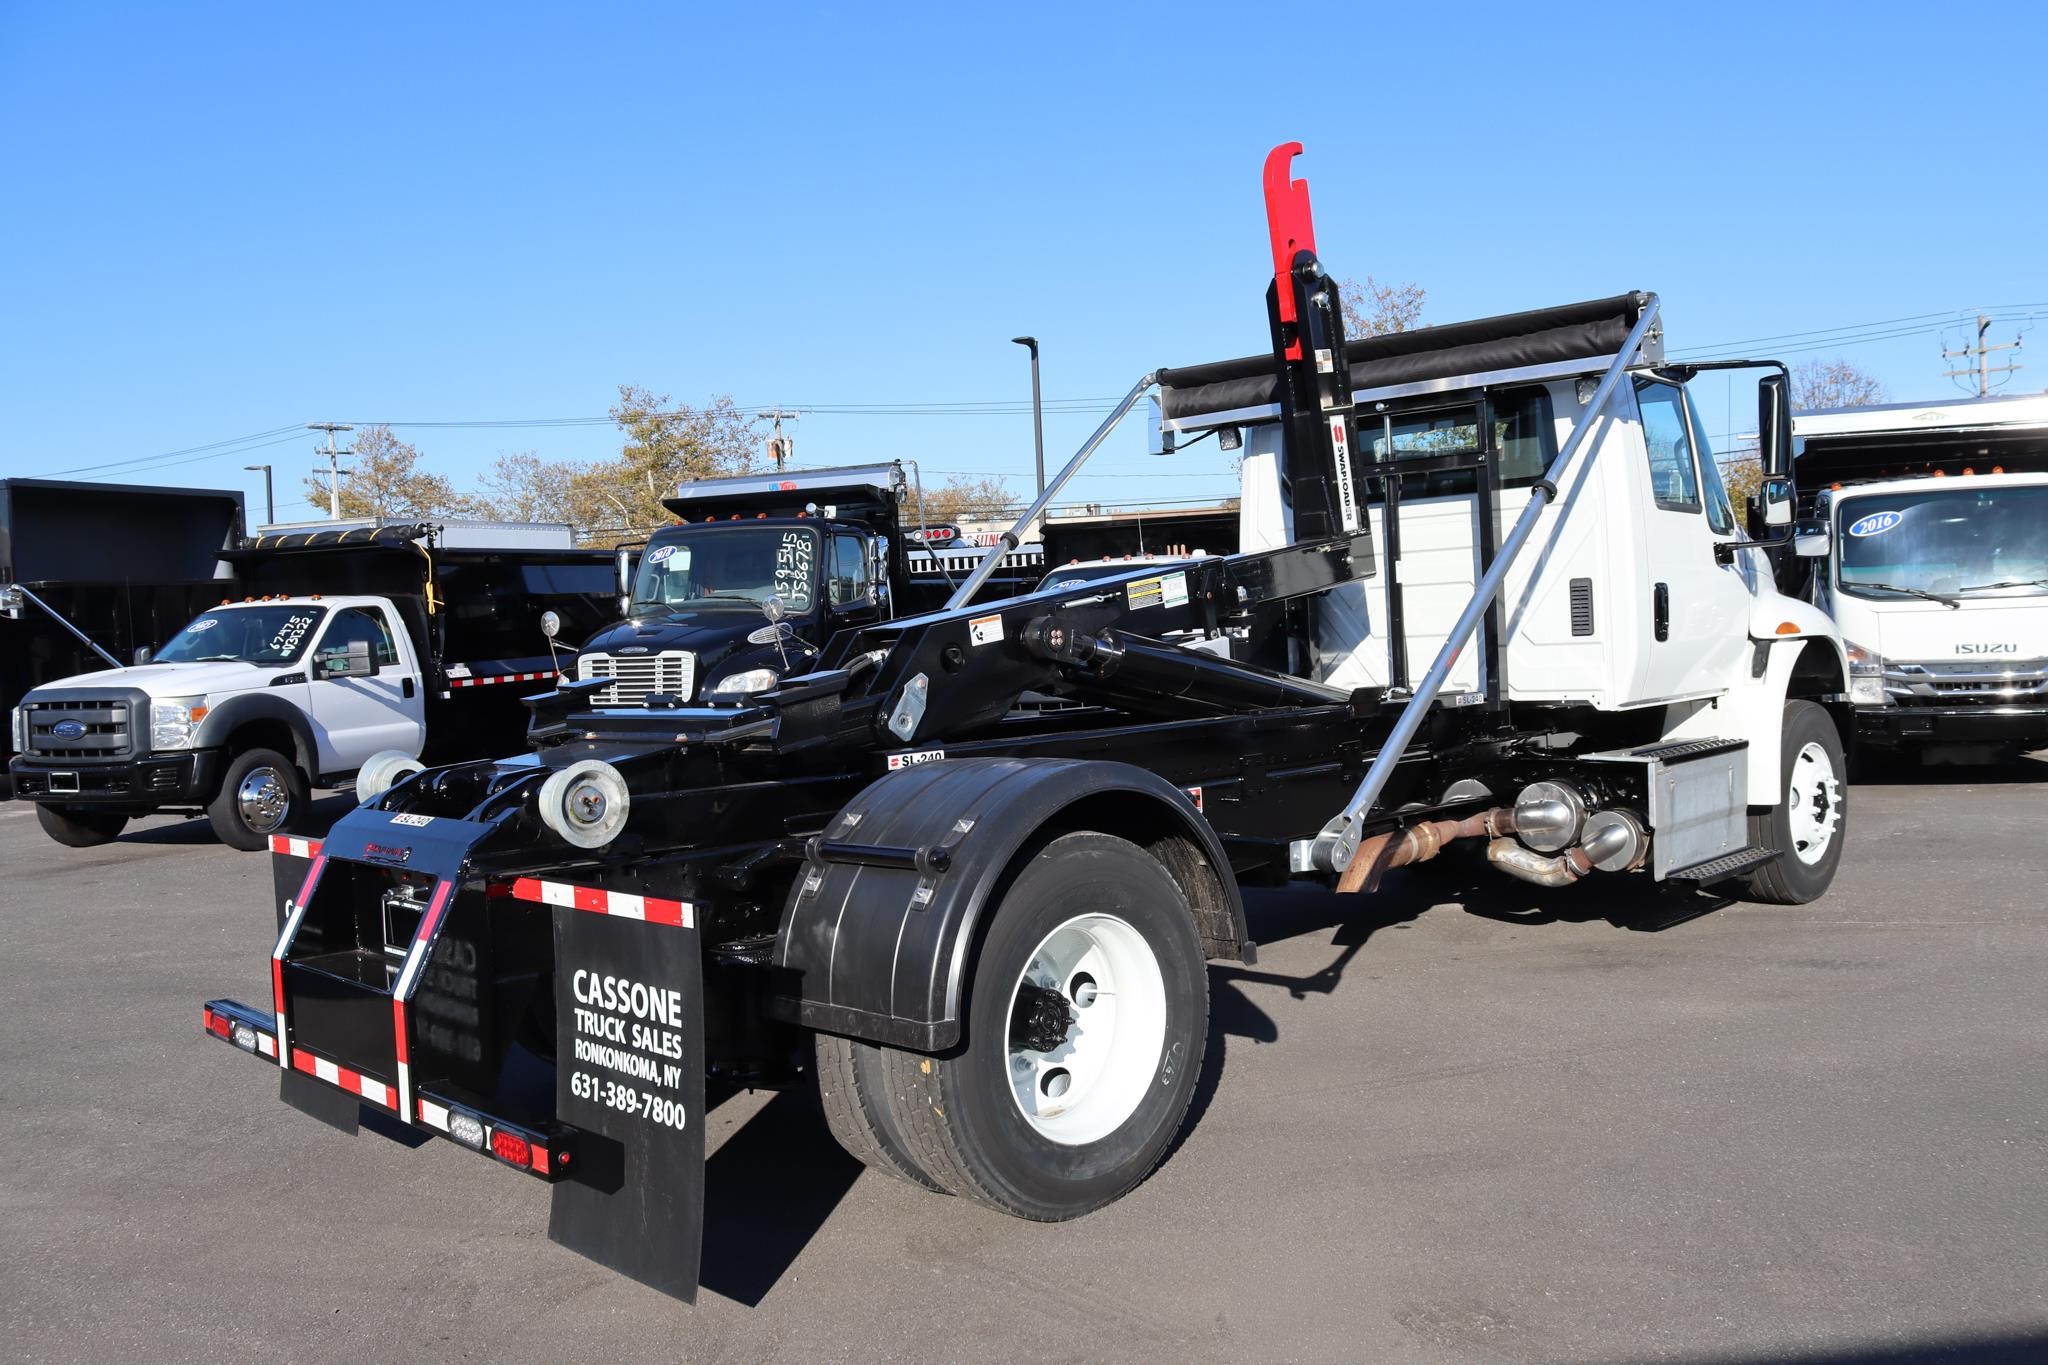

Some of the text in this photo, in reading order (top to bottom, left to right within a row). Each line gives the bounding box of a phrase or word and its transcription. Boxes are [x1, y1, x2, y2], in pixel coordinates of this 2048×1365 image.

[1859, 514, 1892, 535] 2016
[653, 547, 673, 561] 2018
[1954, 643, 2018, 655] ISUZU
[573, 968, 683, 1029] CASSONE
[574, 1007, 683, 1060] TRUCK SALES
[575, 1038, 682, 1090] RONKONKOMA, NY
[571, 1071, 686, 1131] 631-389-7800
